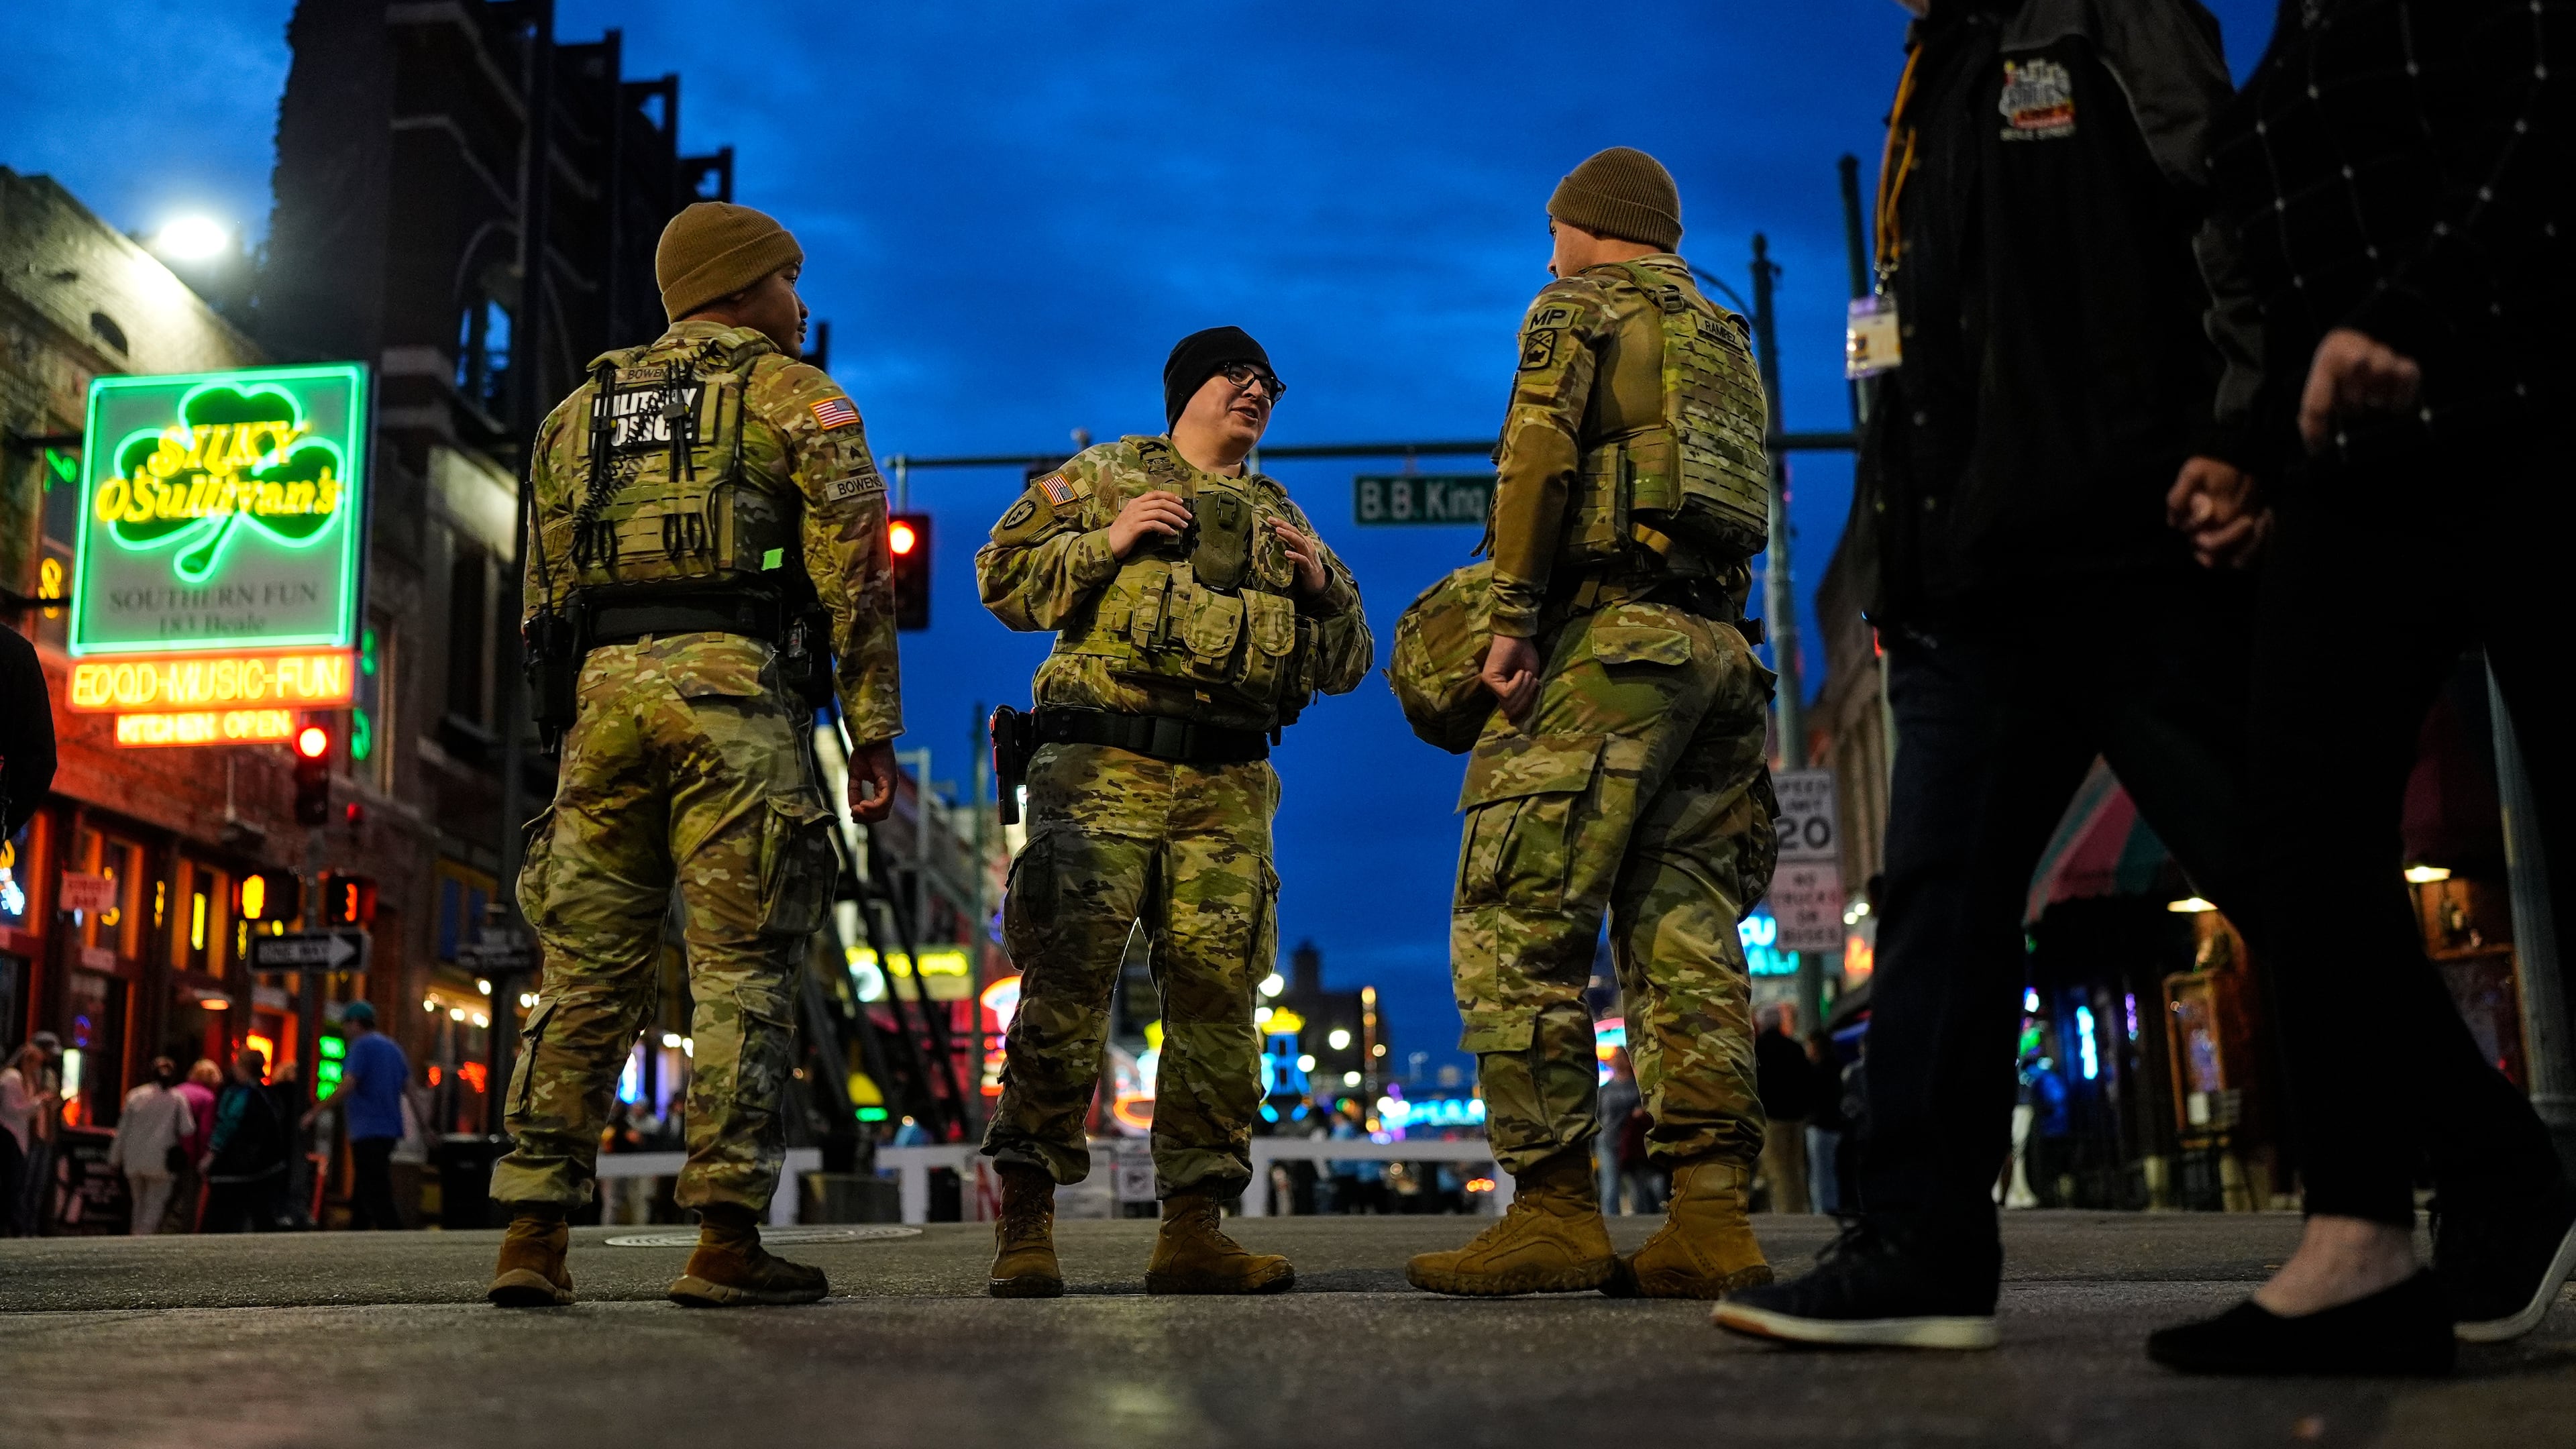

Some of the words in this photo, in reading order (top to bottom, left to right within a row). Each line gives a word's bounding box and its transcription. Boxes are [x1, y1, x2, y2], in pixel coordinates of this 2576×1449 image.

[1529, 309, 1567, 330] MP
[1705, 320, 1737, 345] RAMIREZ
[627, 368, 667, 380] BOWEN
[591, 414, 694, 450] OLIC
[146, 421, 311, 478] SILKY
[837, 475, 883, 495] BOWENS
[1426, 481, 1486, 519] King
[109, 586, 255, 612] SOUTHERN
[264, 582, 319, 605] FUN
[117, 712, 217, 743] KITCHEN
[223, 710, 291, 739] OPEN
[1776, 816, 1831, 849] 20
